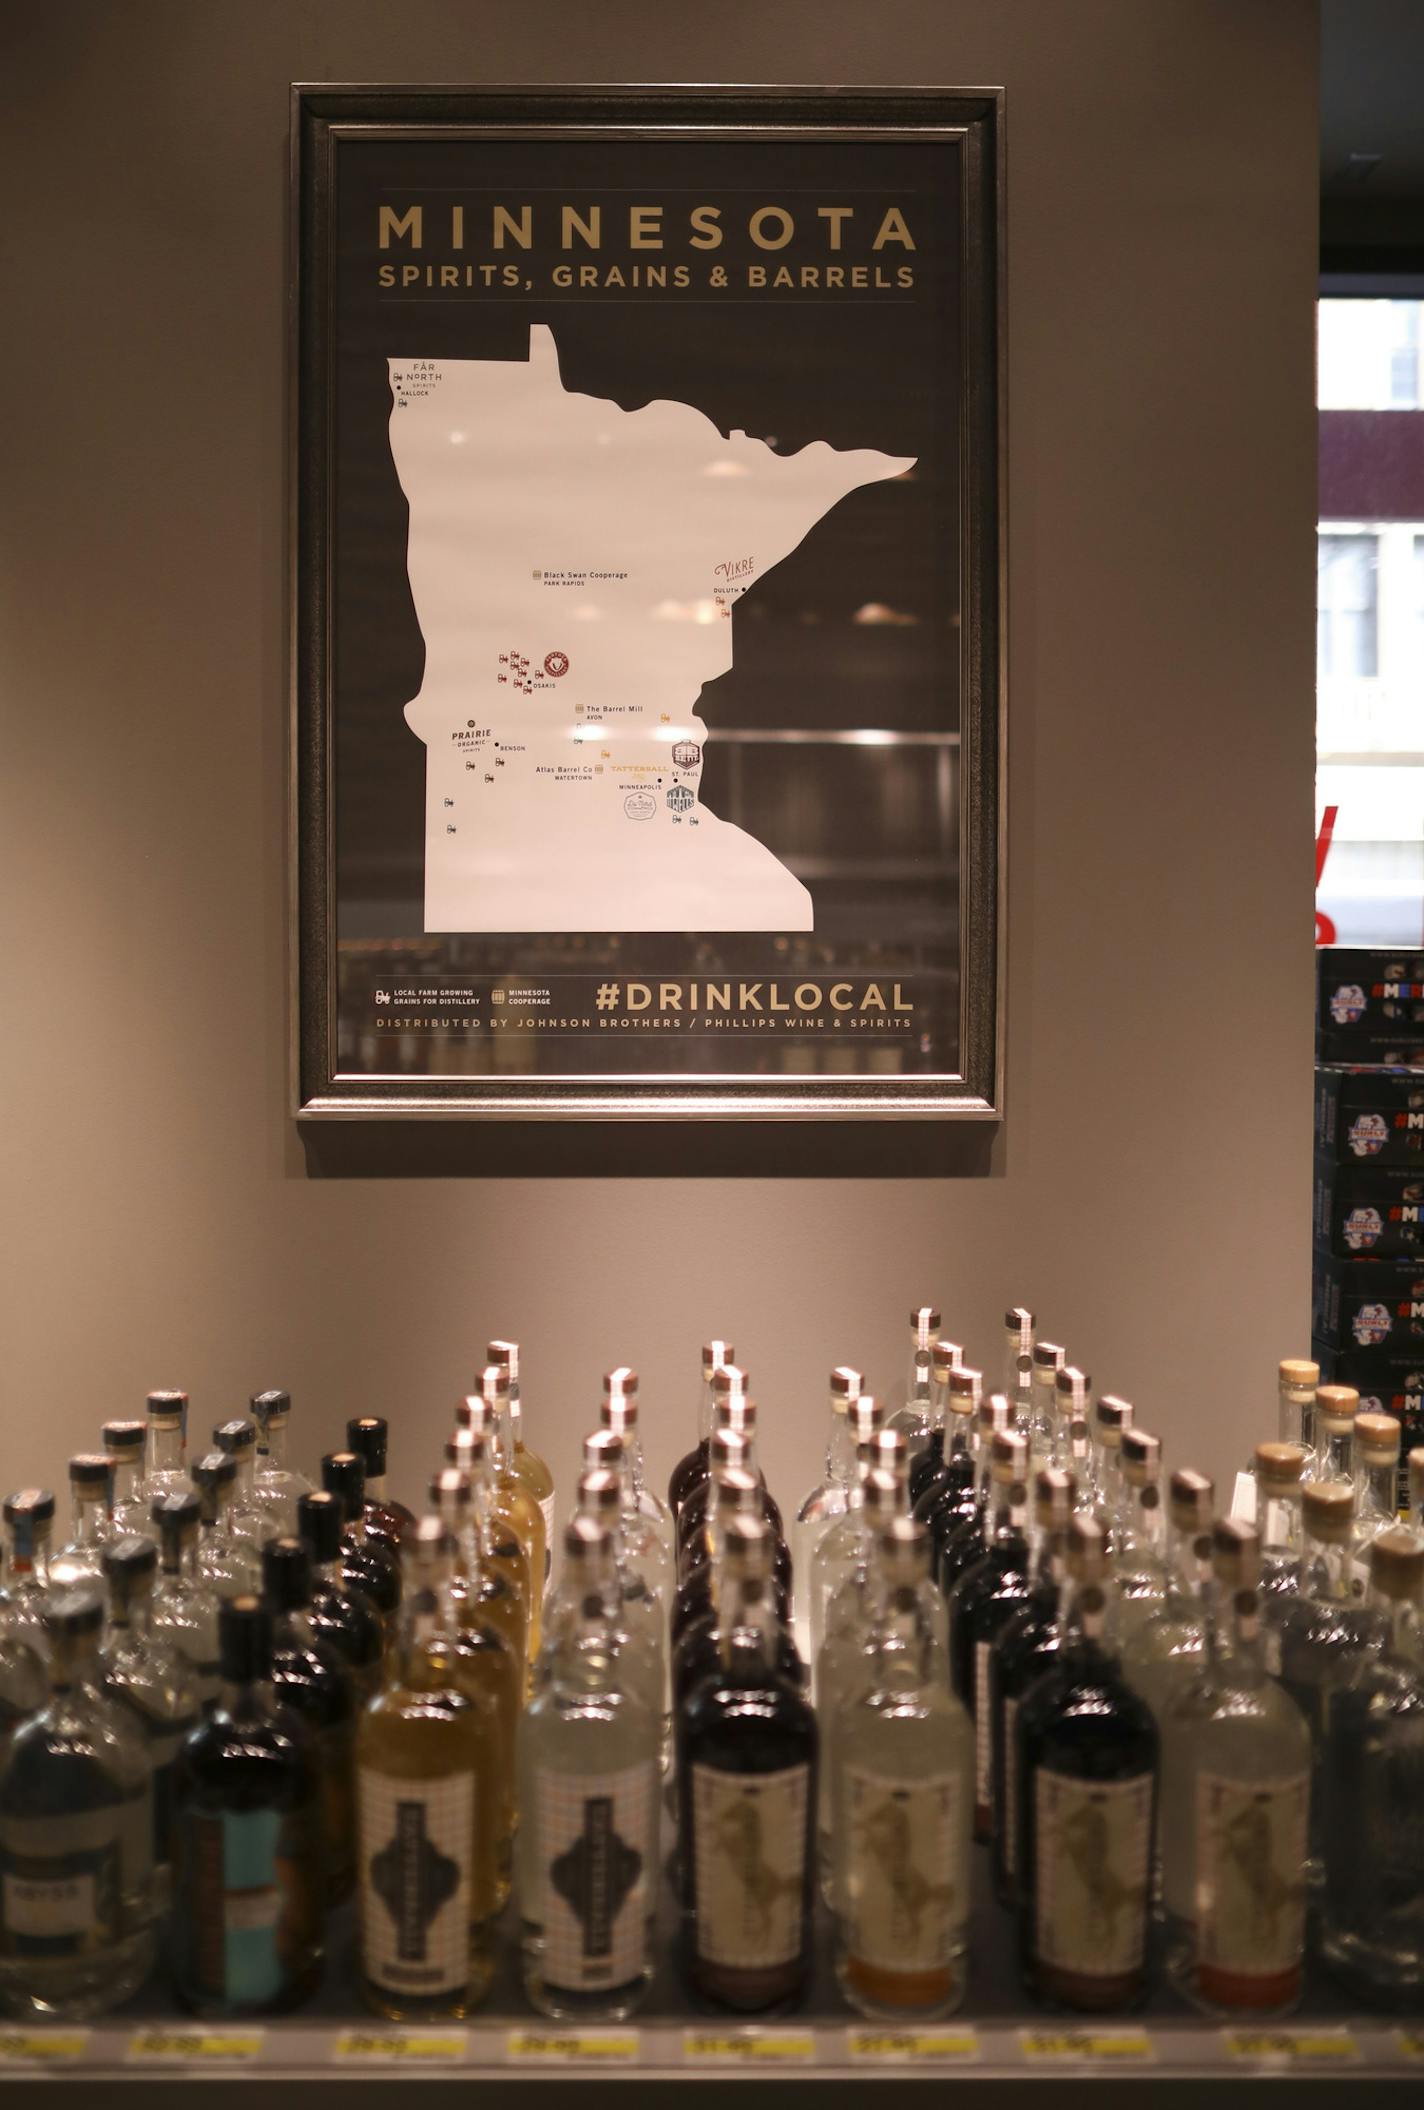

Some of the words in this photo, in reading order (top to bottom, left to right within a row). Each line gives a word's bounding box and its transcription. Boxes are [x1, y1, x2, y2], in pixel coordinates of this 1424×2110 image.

[378, 204, 917, 252] MINNESOTA
[378, 264, 535, 292] SPIRITS,
[551, 264, 692, 288] GRAINS
[708, 264, 730, 288] &
[748, 264, 916, 289] BARRELS
[544, 571, 564, 579] Black
[568, 571, 587, 579] Swan
[590, 571, 628, 580] Cooperage
[714, 556, 754, 577] VIKRE
[452, 729, 491, 740] PRAIRIE
[597, 983, 913, 1011] #DRINKLOCAL
[376, 1019, 482, 1028] DISTRIBUTED
[489, 1019, 508, 1028] BY
[516, 1019, 592, 1028] JOHNSON
[599, 1019, 682, 1028] BROTHERS
[689, 1019, 697, 1028] /
[705, 1019, 776, 1028] PHILLIPS
[785, 1019, 824, 1028] WINE
[833, 1019, 841, 1028] &
[850, 1019, 912, 1028] SPIRITS
